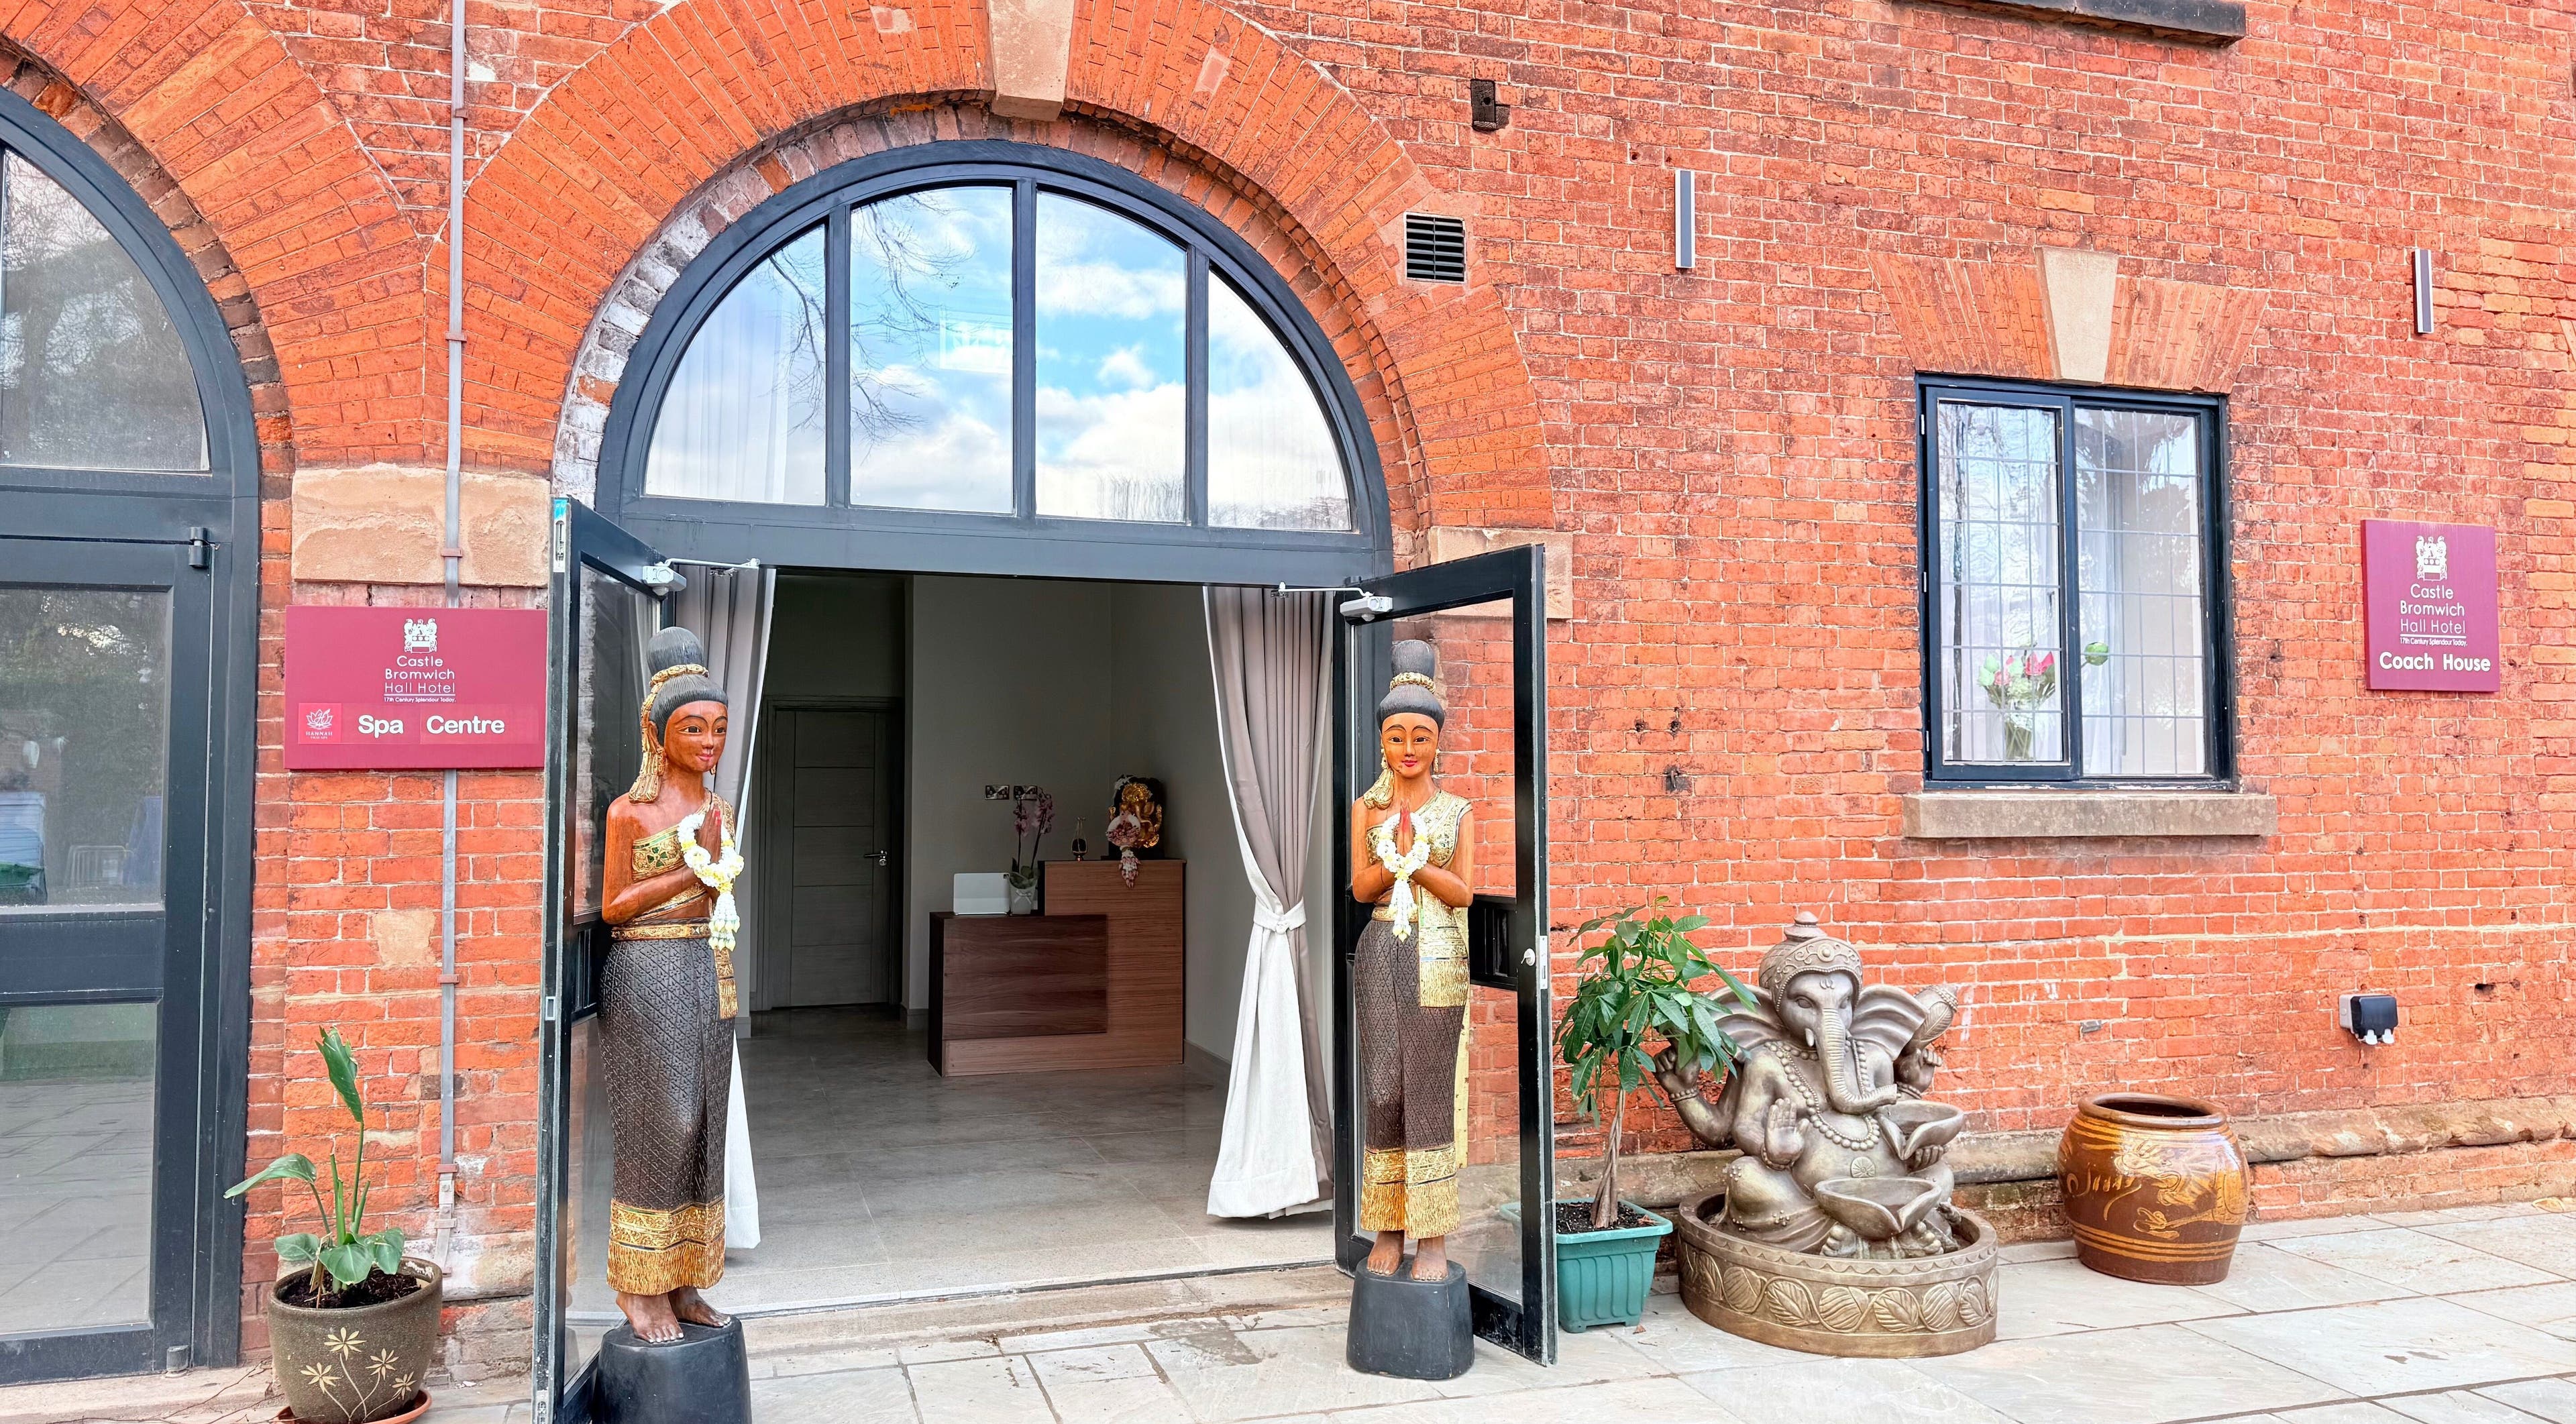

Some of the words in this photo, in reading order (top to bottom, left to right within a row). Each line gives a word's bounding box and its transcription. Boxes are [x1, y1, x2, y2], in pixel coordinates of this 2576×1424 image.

[2410, 584, 2454, 600] Castle
[2400, 600, 2465, 617] Bromwich
[2400, 618, 2426, 633] Hall
[2430, 619, 2466, 635] Hotel
[2400, 637, 2410, 645] 17th
[2410, 638, 2428, 646] Century
[2429, 638, 2453, 646] Splendour
[396, 655, 443, 667] Castle
[2379, 651, 2434, 671] Coach
[2443, 653, 2491, 672] House
[385, 668, 455, 680] Bromwich
[384, 682, 413, 693] Hall
[418, 682, 455, 694] Hotel
[358, 714, 405, 738] Spa
[426, 715, 506, 734] Centre
